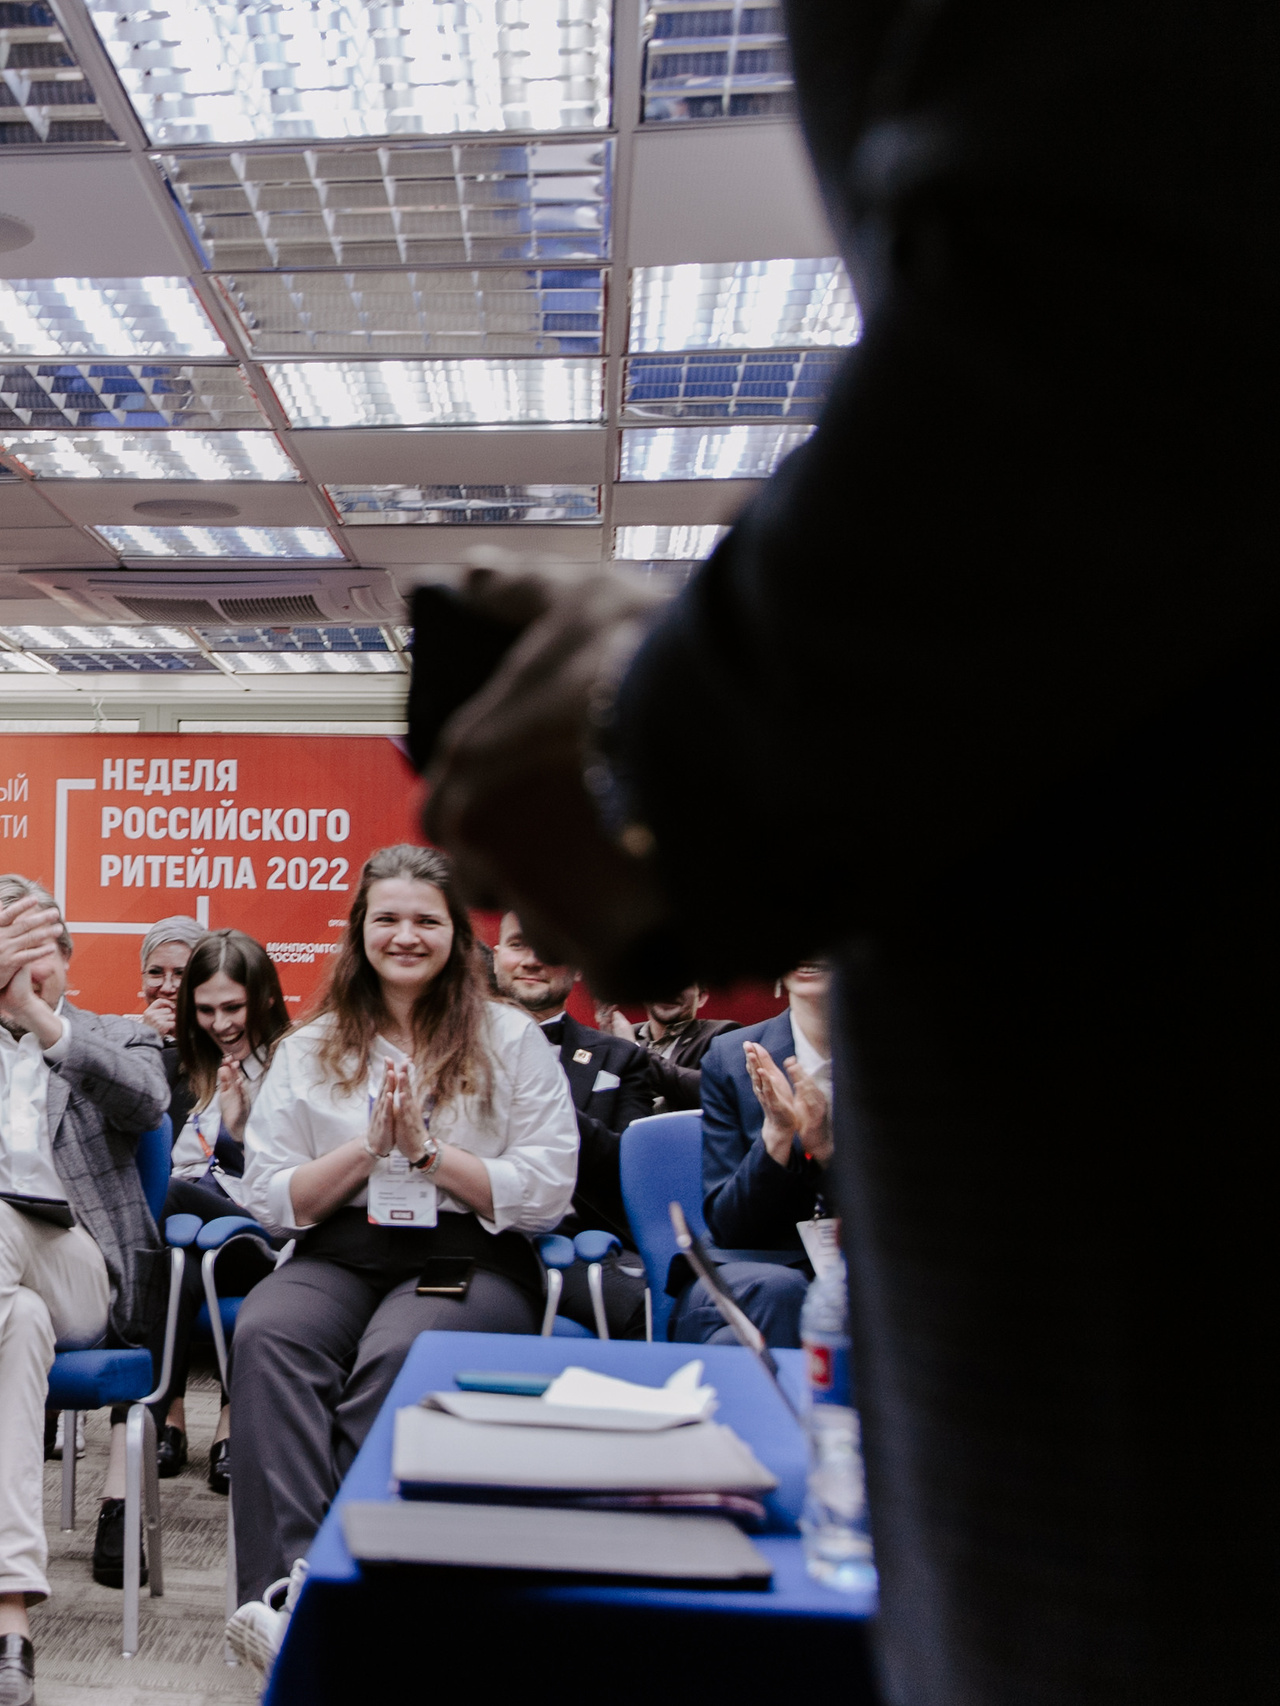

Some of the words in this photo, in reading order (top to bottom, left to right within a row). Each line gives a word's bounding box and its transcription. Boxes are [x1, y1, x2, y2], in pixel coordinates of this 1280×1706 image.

[101, 758, 238, 795] НЕДЕЛЯ
[100, 799, 351, 843] РОССИЙСКОГО
[99, 847, 258, 890] РИТЕЙЛА
[266, 856, 350, 891] 2022
